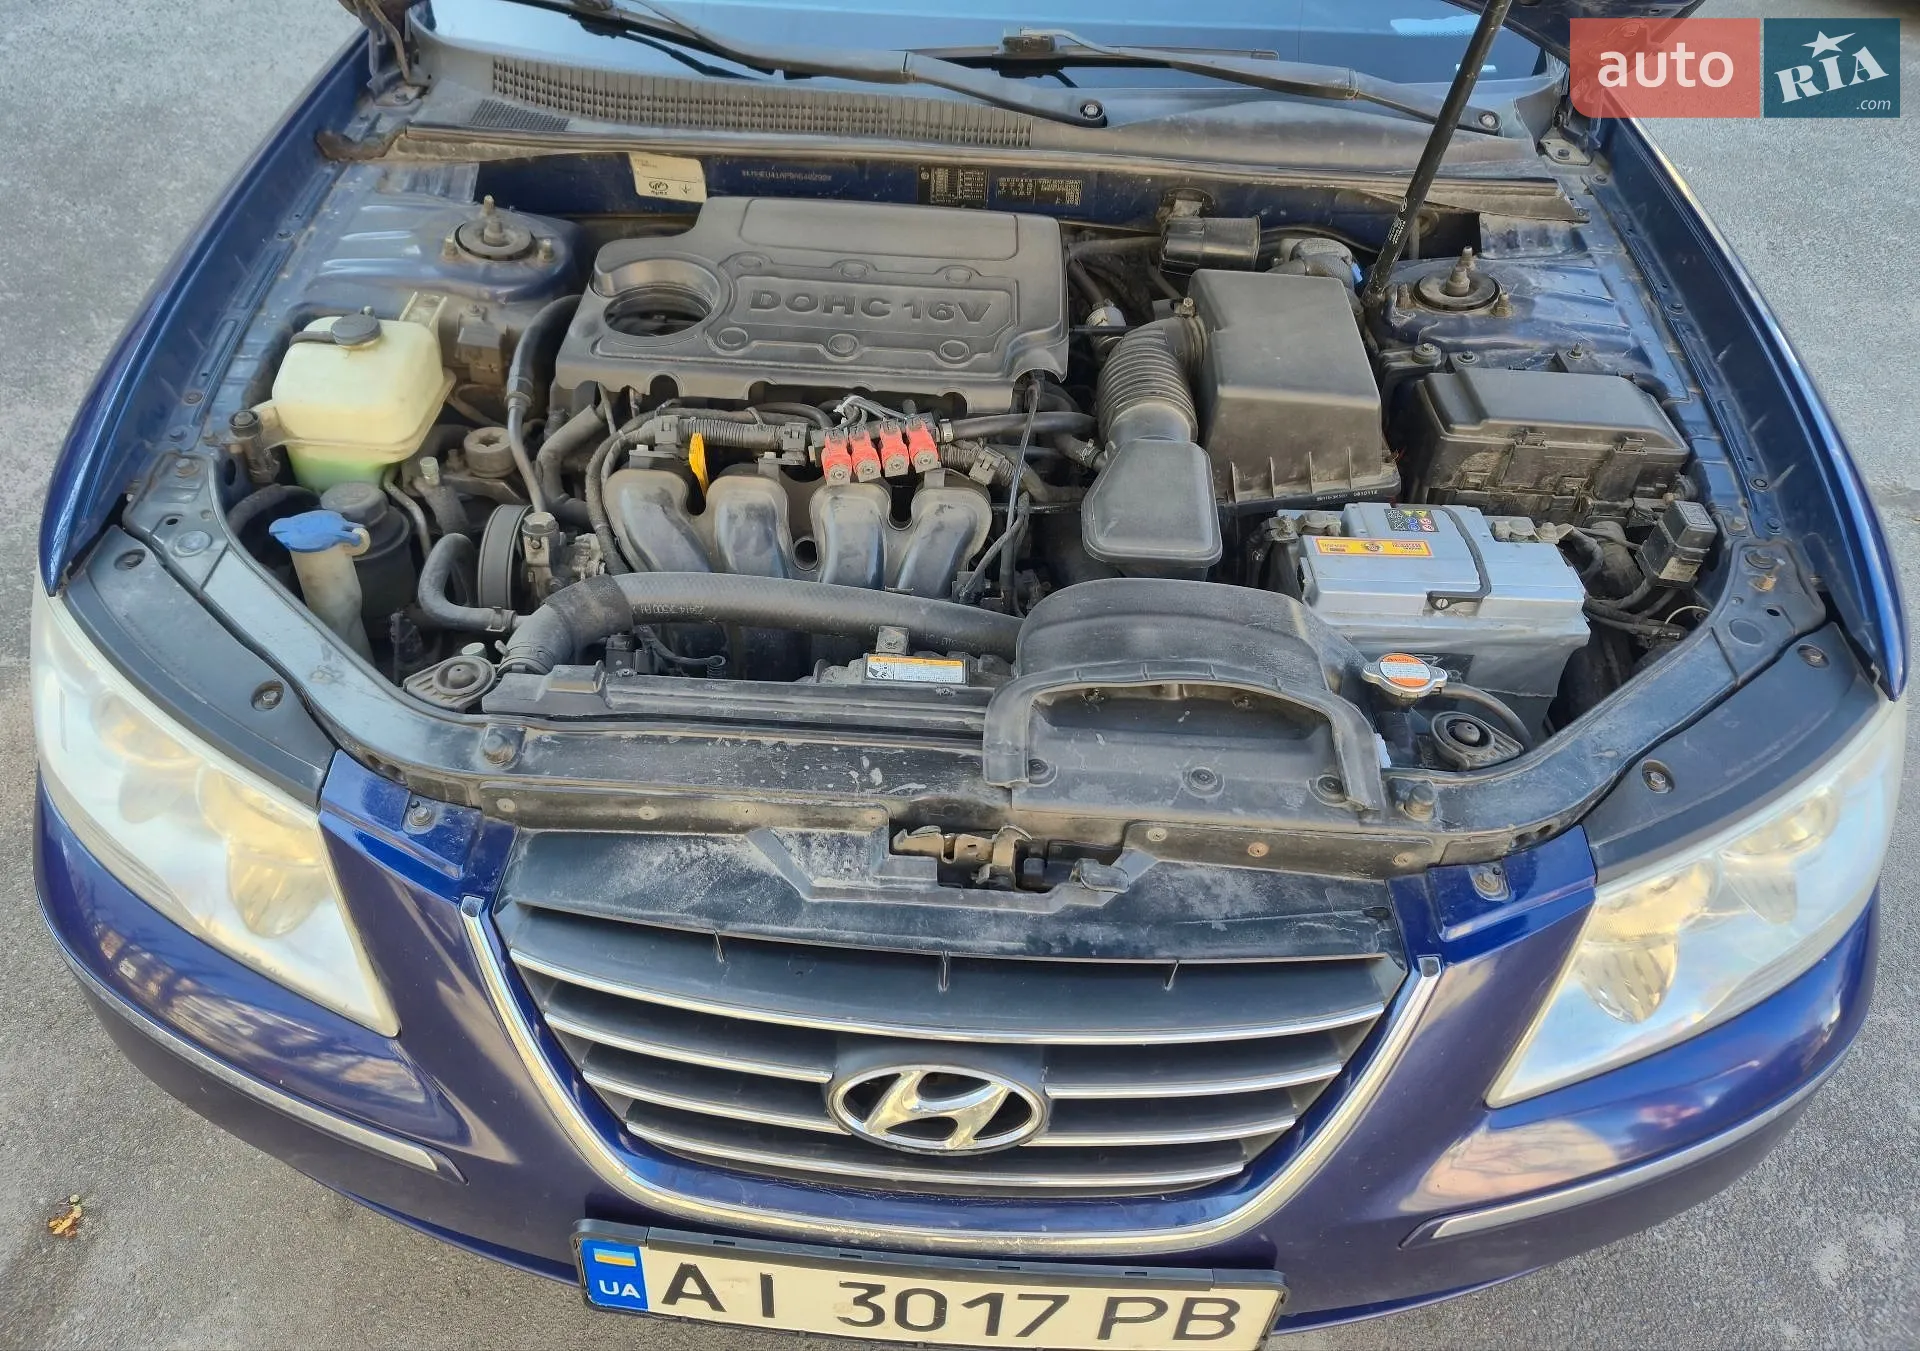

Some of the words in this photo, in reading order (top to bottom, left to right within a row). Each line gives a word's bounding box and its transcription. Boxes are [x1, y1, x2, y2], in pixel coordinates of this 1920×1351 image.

[750, 289, 892, 318] DOHC
[902, 299, 992, 323] 16V
[599, 1279, 641, 1299] UA
[836, 1280, 1070, 1338] 3017
[1097, 1296, 1241, 1341] PB
